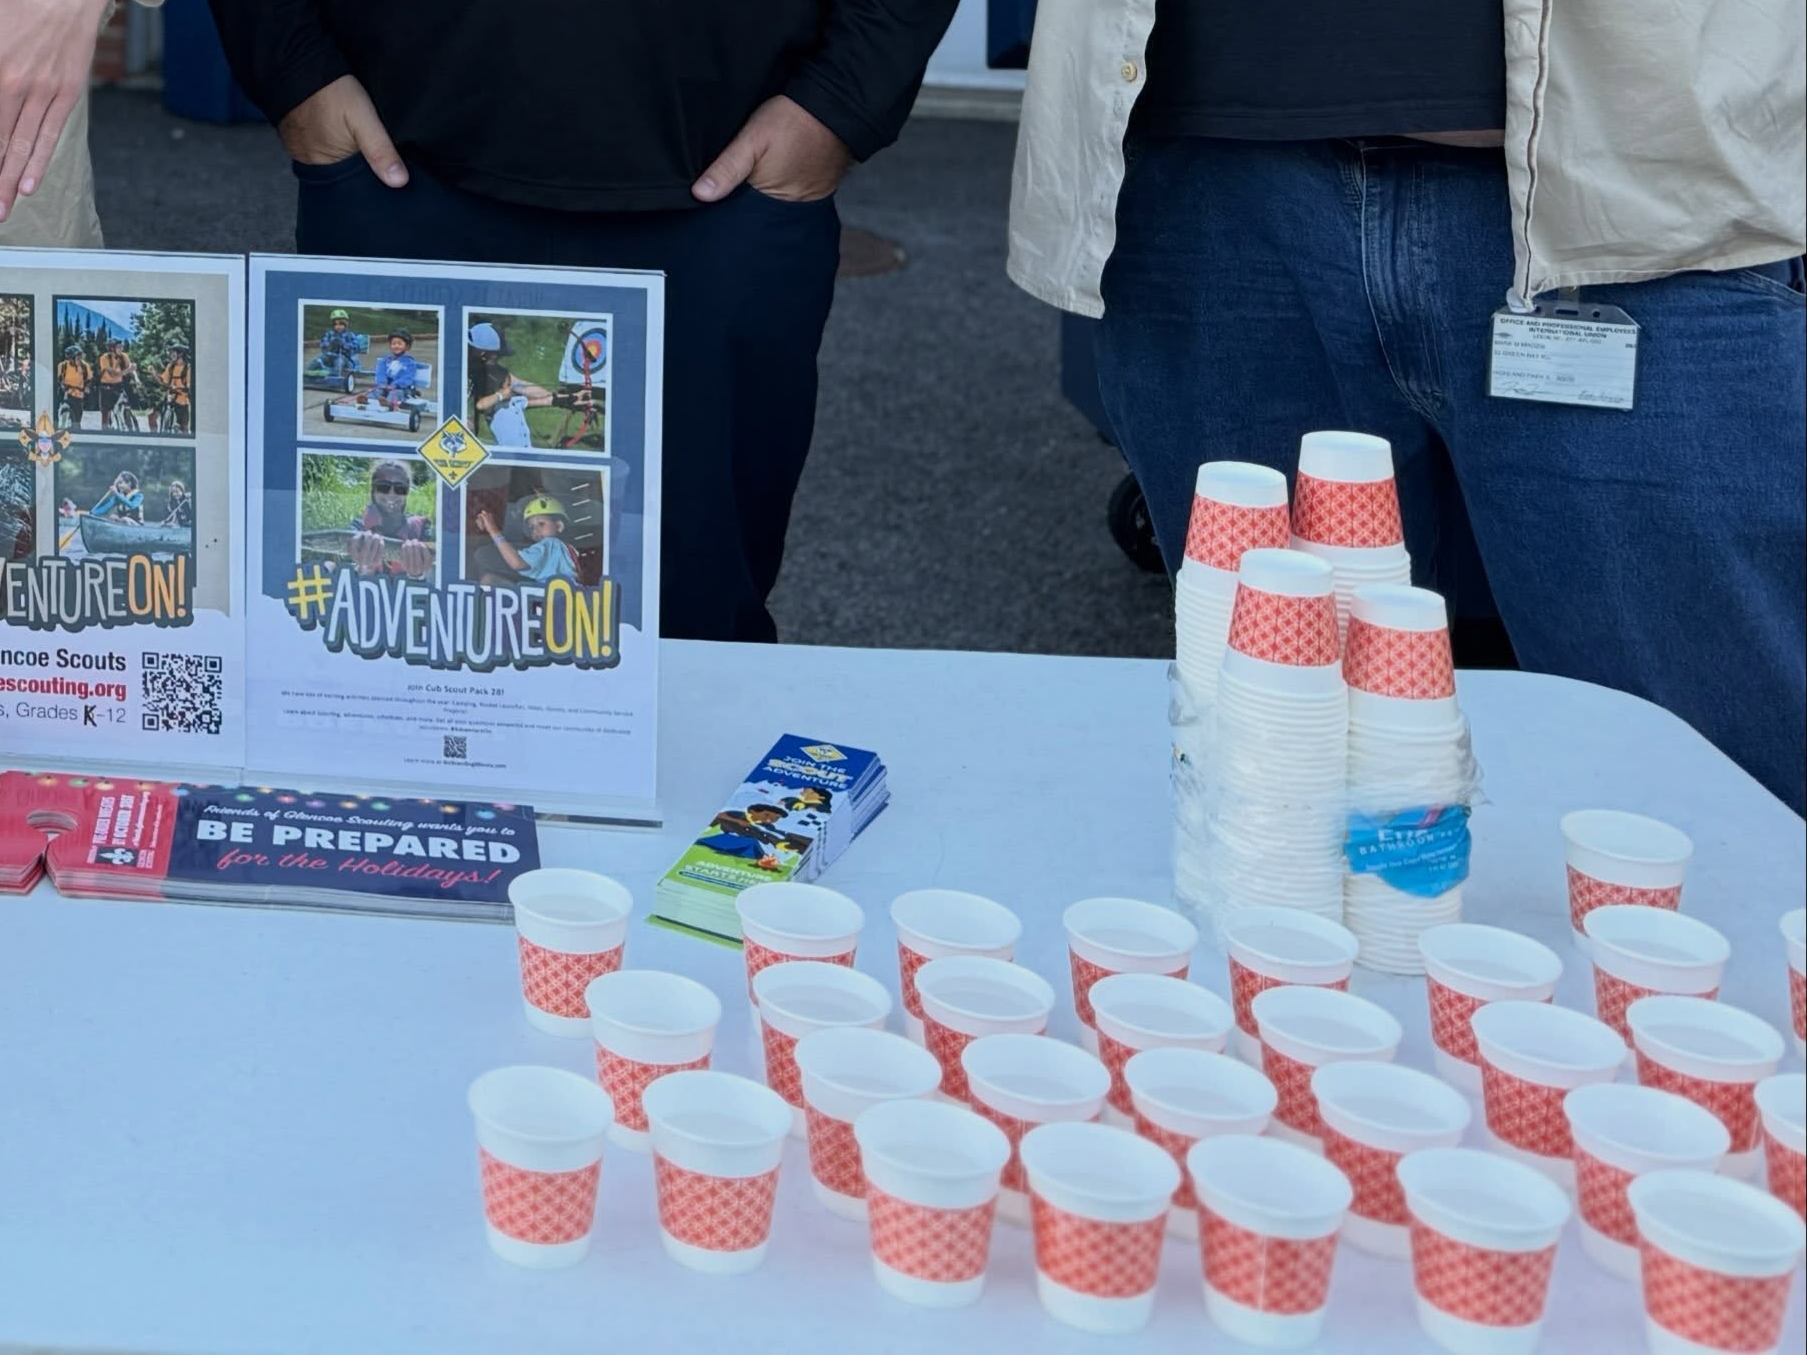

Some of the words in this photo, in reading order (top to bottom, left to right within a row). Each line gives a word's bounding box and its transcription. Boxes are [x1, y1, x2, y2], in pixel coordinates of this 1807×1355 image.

[56, 648, 126, 671] Scouts
[407, 684, 423, 692] Join
[425, 684, 442, 693] Cub
[444, 686, 467, 694] Scout
[470, 687, 488, 695] Pack
[16, 702, 78, 720] Grades
[83, 704, 126, 727] K-12
[783, 756, 817, 767] JOIN
[820, 764, 847, 773] THE
[762, 766, 848, 789] ADVENTURE
[204, 804, 260, 817] Friends
[264, 809, 280, 820] of
[283, 810, 343, 823] Glencoe
[346, 815, 414, 831] Scouting
[418, 821, 463, 833] wants
[465, 825, 498, 836] you
[503, 826, 516, 836] to
[196, 819, 254, 844] BE
[272, 824, 521, 864] PREPARED
[217, 848, 269, 870] for
[278, 853, 329, 870] the
[337, 857, 501, 888] Holidays!
